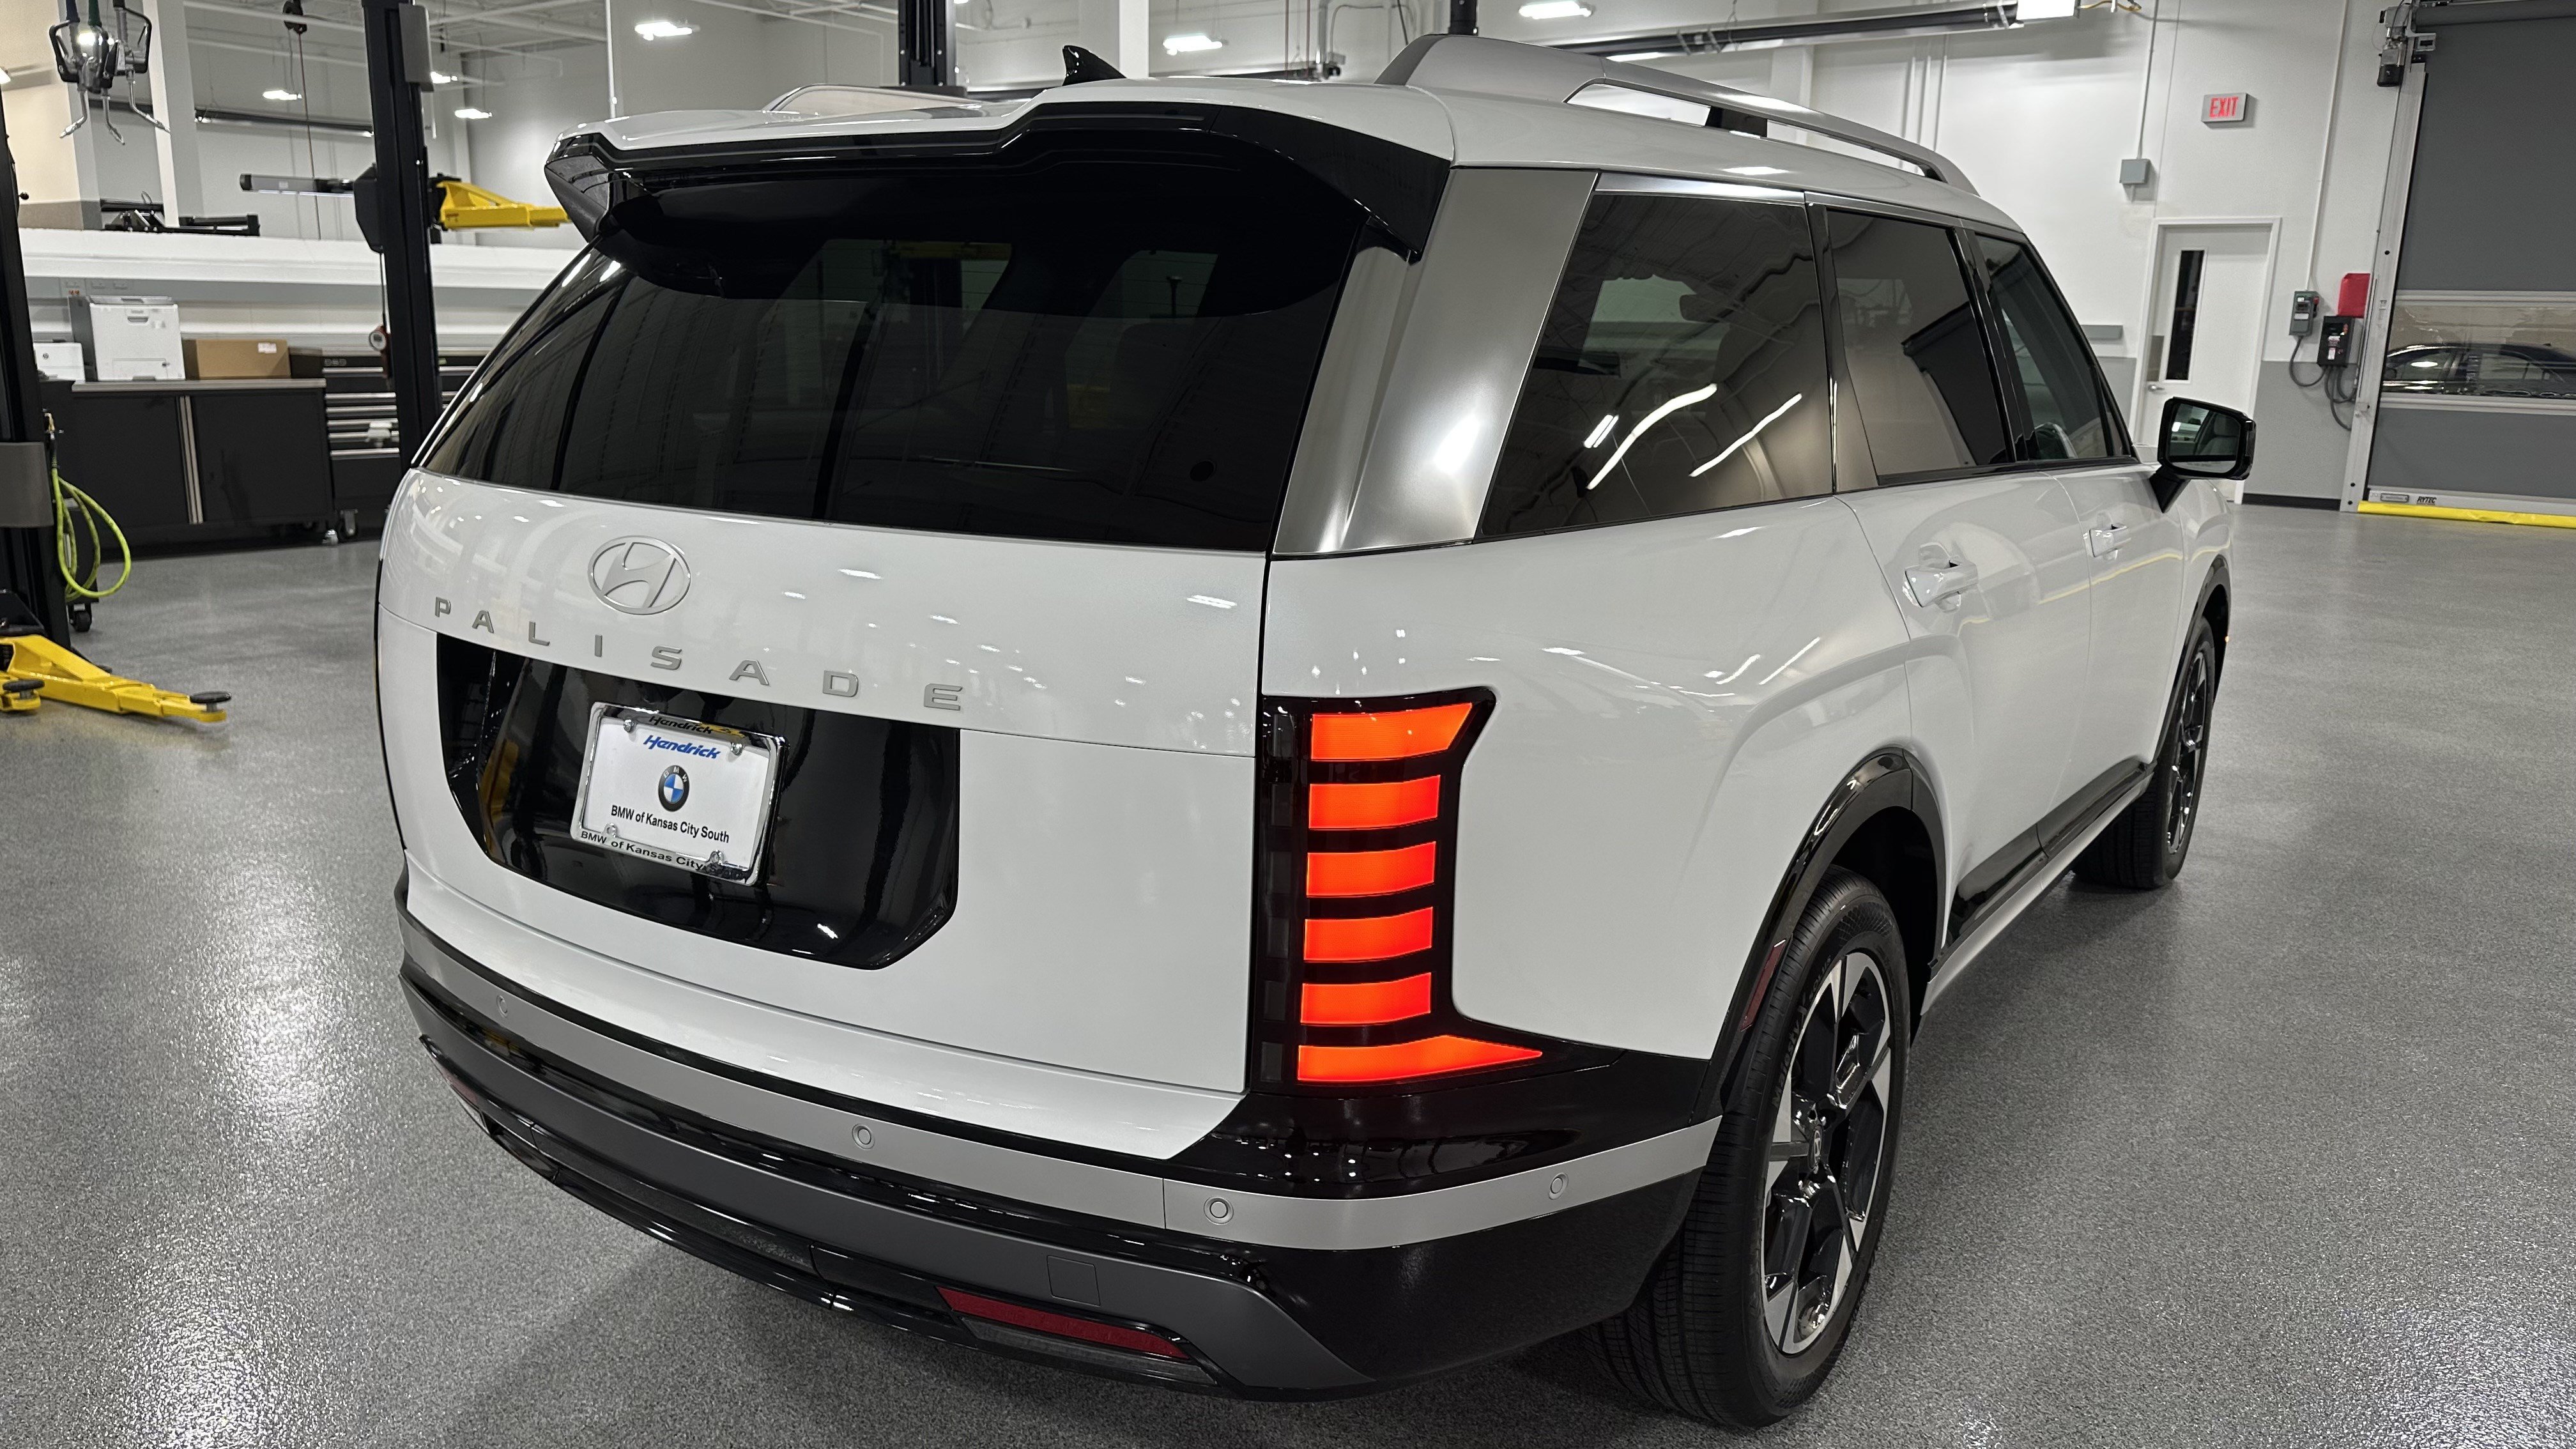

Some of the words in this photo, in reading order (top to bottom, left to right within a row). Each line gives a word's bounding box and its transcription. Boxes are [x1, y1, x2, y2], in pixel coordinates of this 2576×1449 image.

[2209, 96, 2239, 118] EXIT
[434, 596, 964, 711] PALISADE
[649, 716, 714, 734] Hendrick
[643, 735, 721, 759] Hendrick
[664, 766, 688, 783] BMW
[611, 804, 634, 820] BMW
[635, 812, 645, 822] of
[646, 813, 678, 831] Kansas
[680, 822, 699, 838] City
[701, 826, 730, 843] South
[581, 831, 607, 844] BMW
[626, 843, 672, 861] Kansas
[676, 856, 703, 871] City
